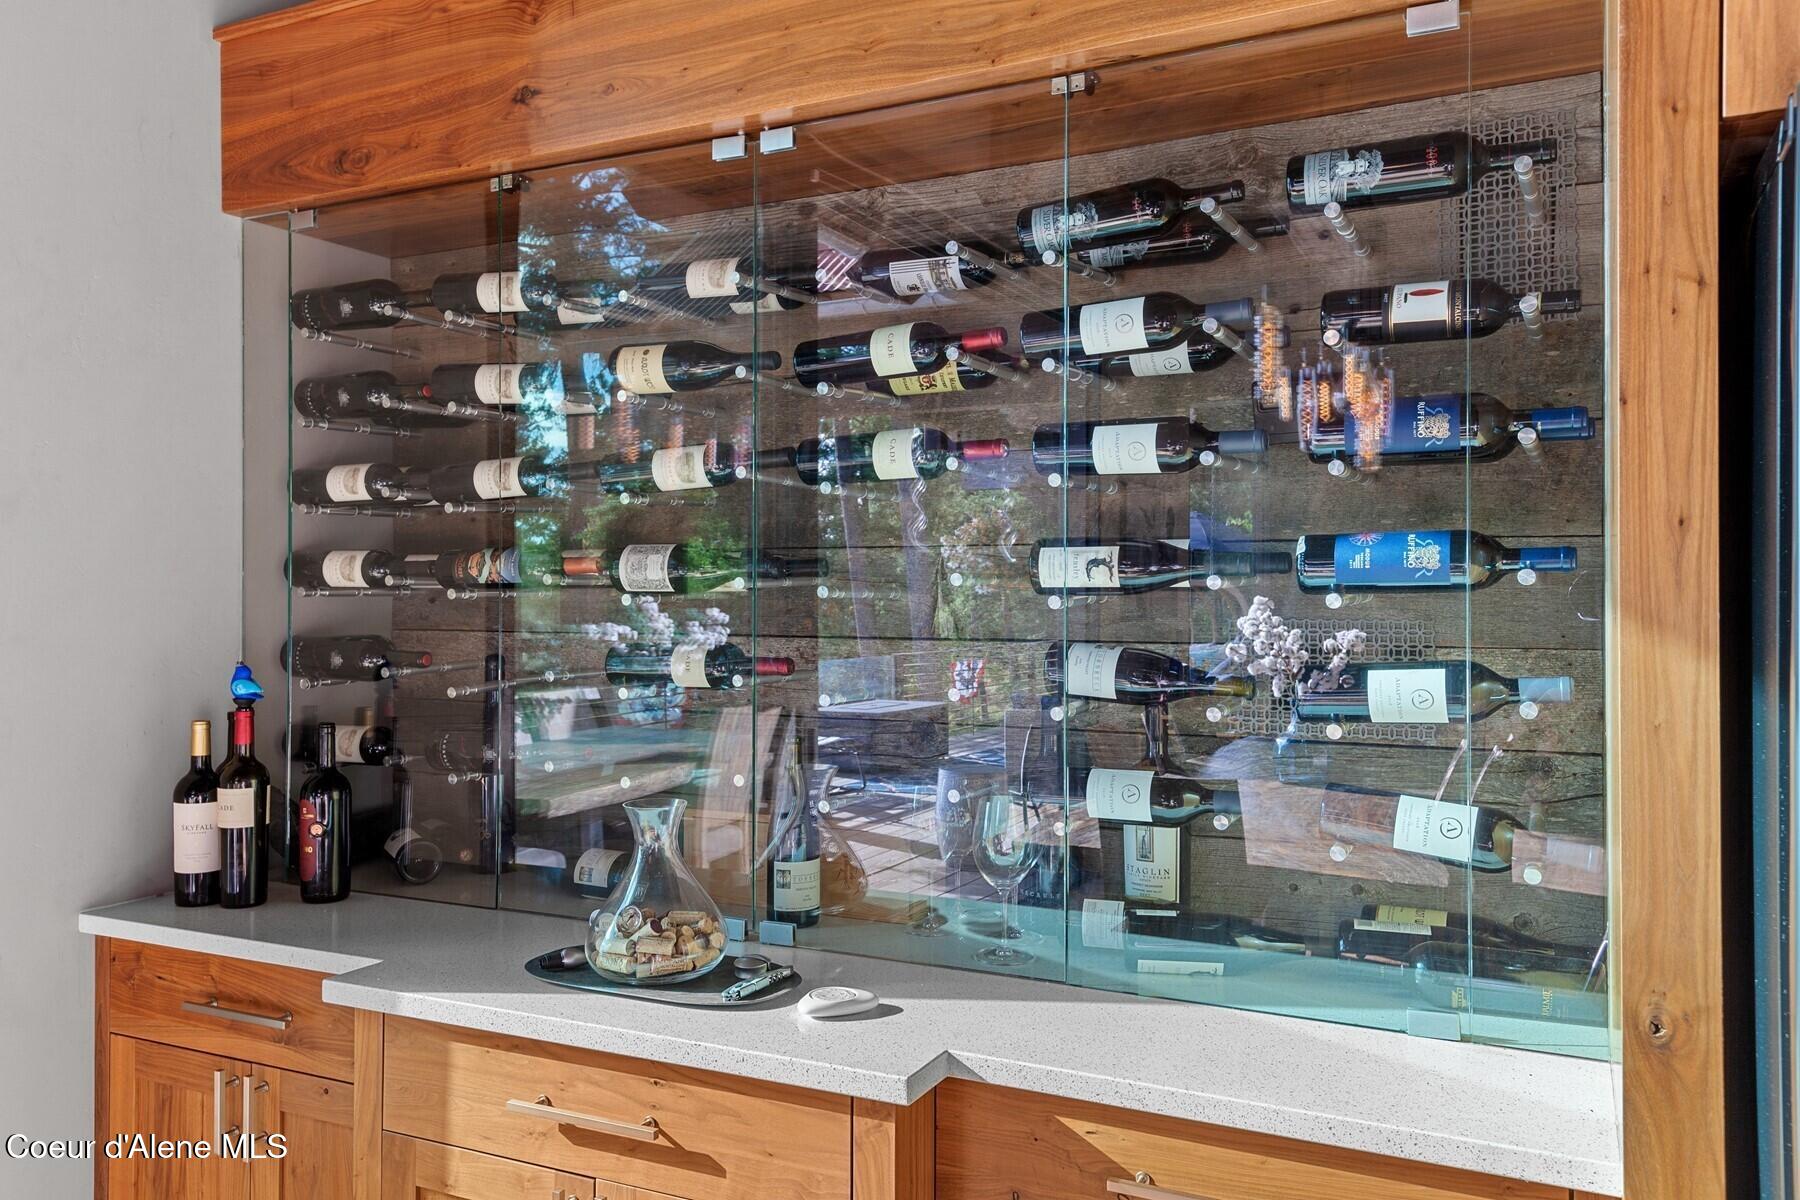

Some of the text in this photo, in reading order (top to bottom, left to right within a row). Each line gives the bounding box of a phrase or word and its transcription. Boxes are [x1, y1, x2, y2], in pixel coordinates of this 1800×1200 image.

[1318, 155, 1328, 198] SILVER OAK
[1043, 210, 1051, 233] SILVER
[1417, 402, 1425, 438] RUFFINO
[1407, 534, 1415, 568] RUFFINO
[1395, 677, 1403, 719] ADAPTATION
[1422, 804, 1433, 848] ADAPTATION
[1126, 864, 1170, 875] STAGLIN
